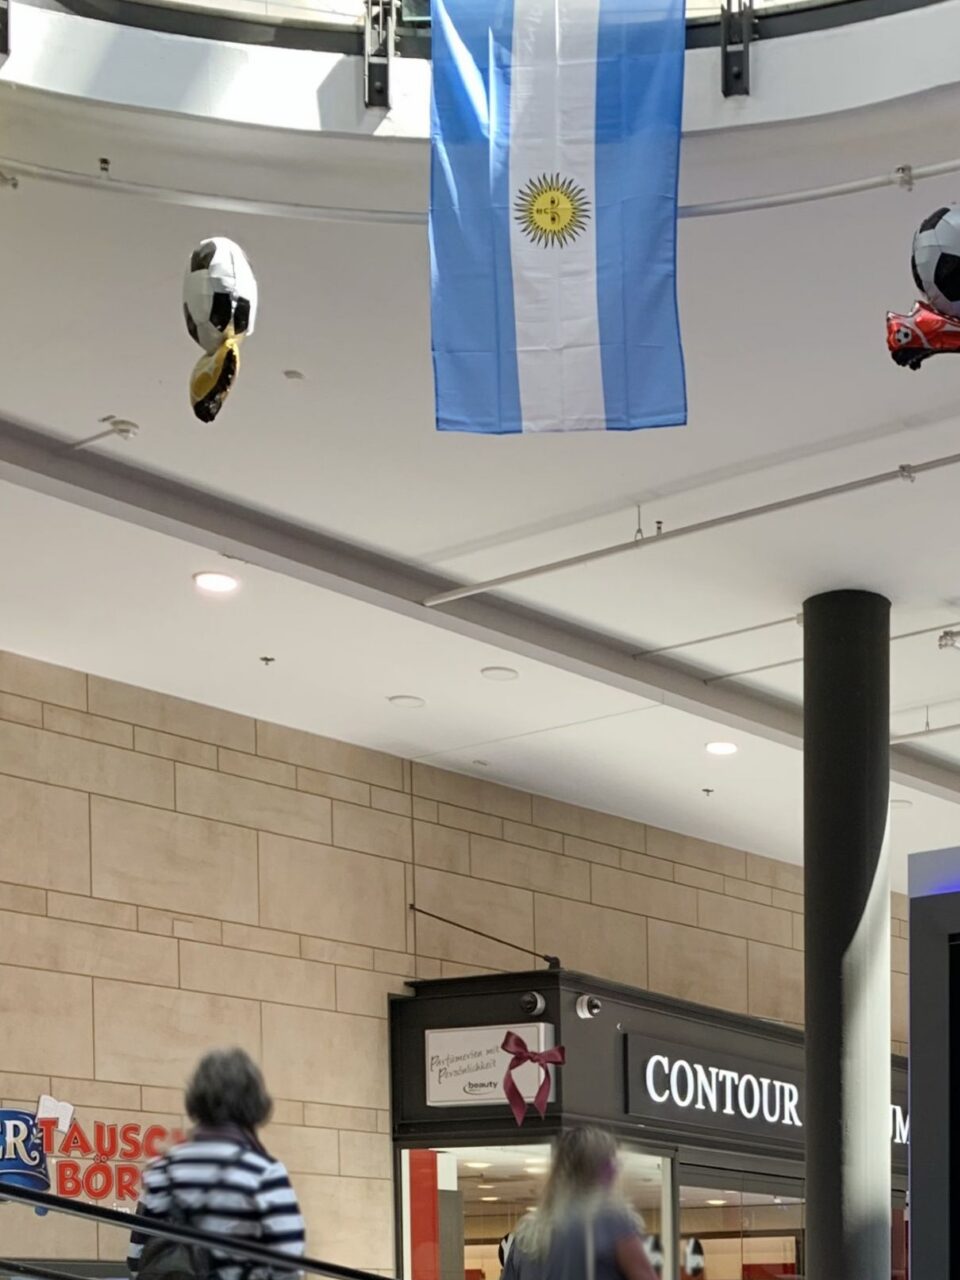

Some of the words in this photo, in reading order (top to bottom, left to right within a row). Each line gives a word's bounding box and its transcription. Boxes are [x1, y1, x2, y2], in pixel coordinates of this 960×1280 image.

[468, 1081, 498, 1090] beauty
[645, 1054, 803, 1127] CONTOUR
[56, 1154, 142, 1200] BÖR
